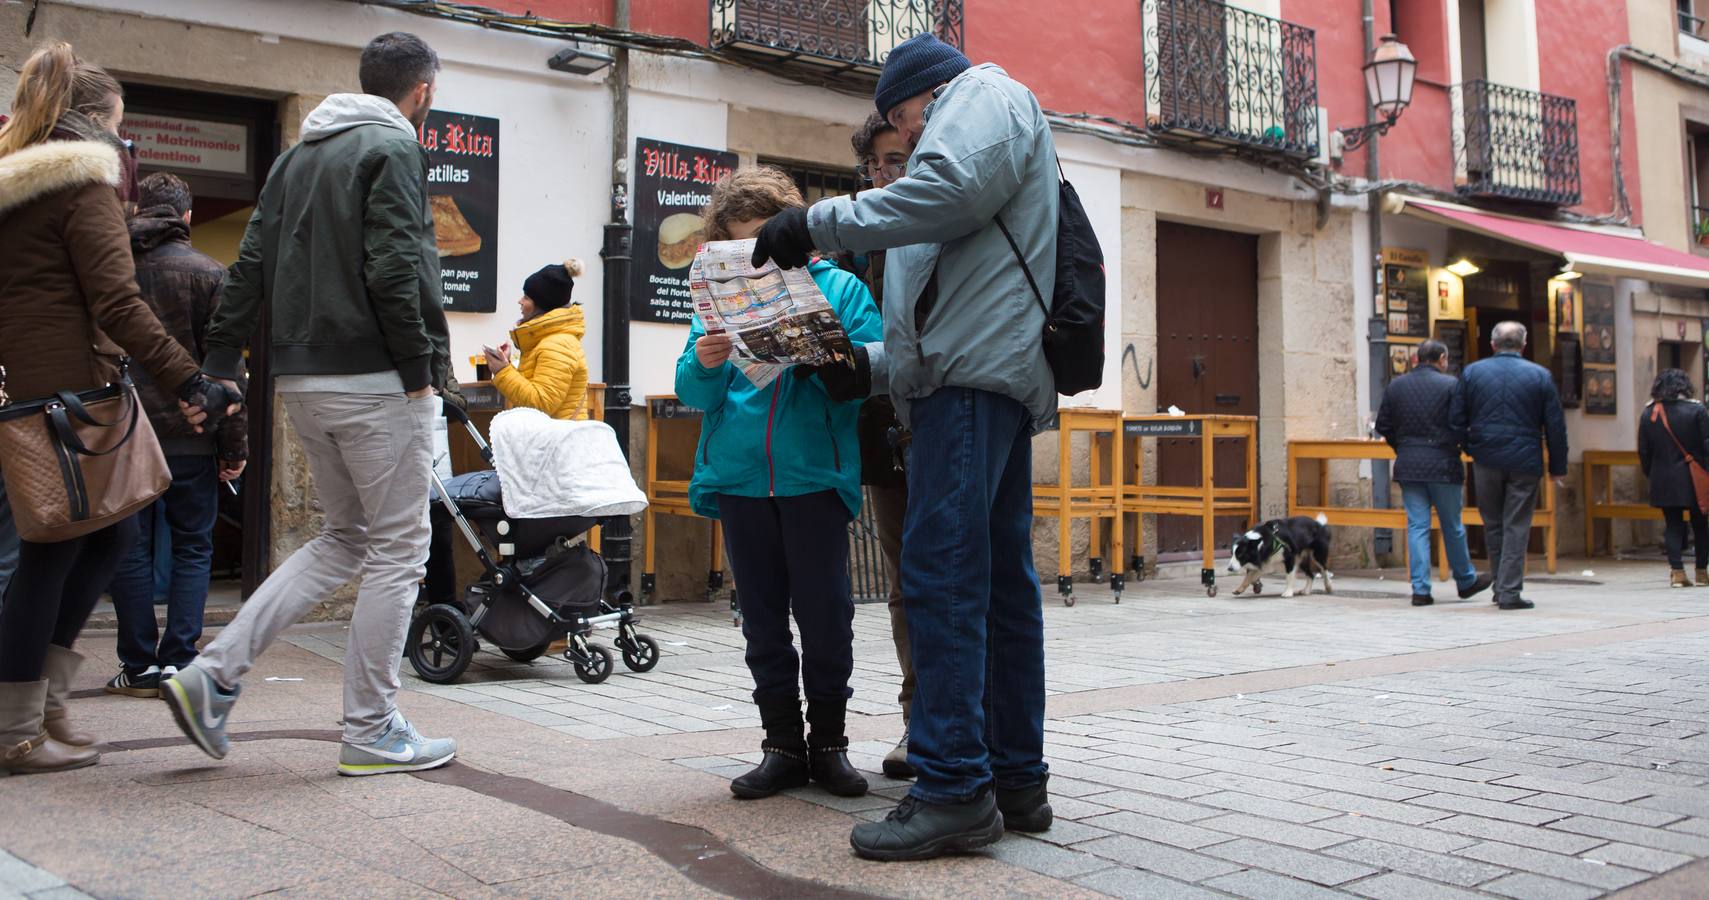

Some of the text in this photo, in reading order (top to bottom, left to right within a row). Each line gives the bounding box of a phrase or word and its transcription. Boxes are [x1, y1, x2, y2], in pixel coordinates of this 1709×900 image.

[156, 133, 241, 152] Matrimonios
[418, 121, 493, 158] la-Rica
[136, 147, 202, 164] alentinos
[427, 164, 470, 183] atillas
[657, 190, 712, 206] Valentinos
[441, 269, 479, 280] pan payes
[444, 281, 471, 292] tomate
[656, 287, 669, 296] del
[670, 288, 691, 297] Norte
[650, 298, 670, 307] salsa
[671, 299, 681, 308] de
[662, 309, 670, 318] la
